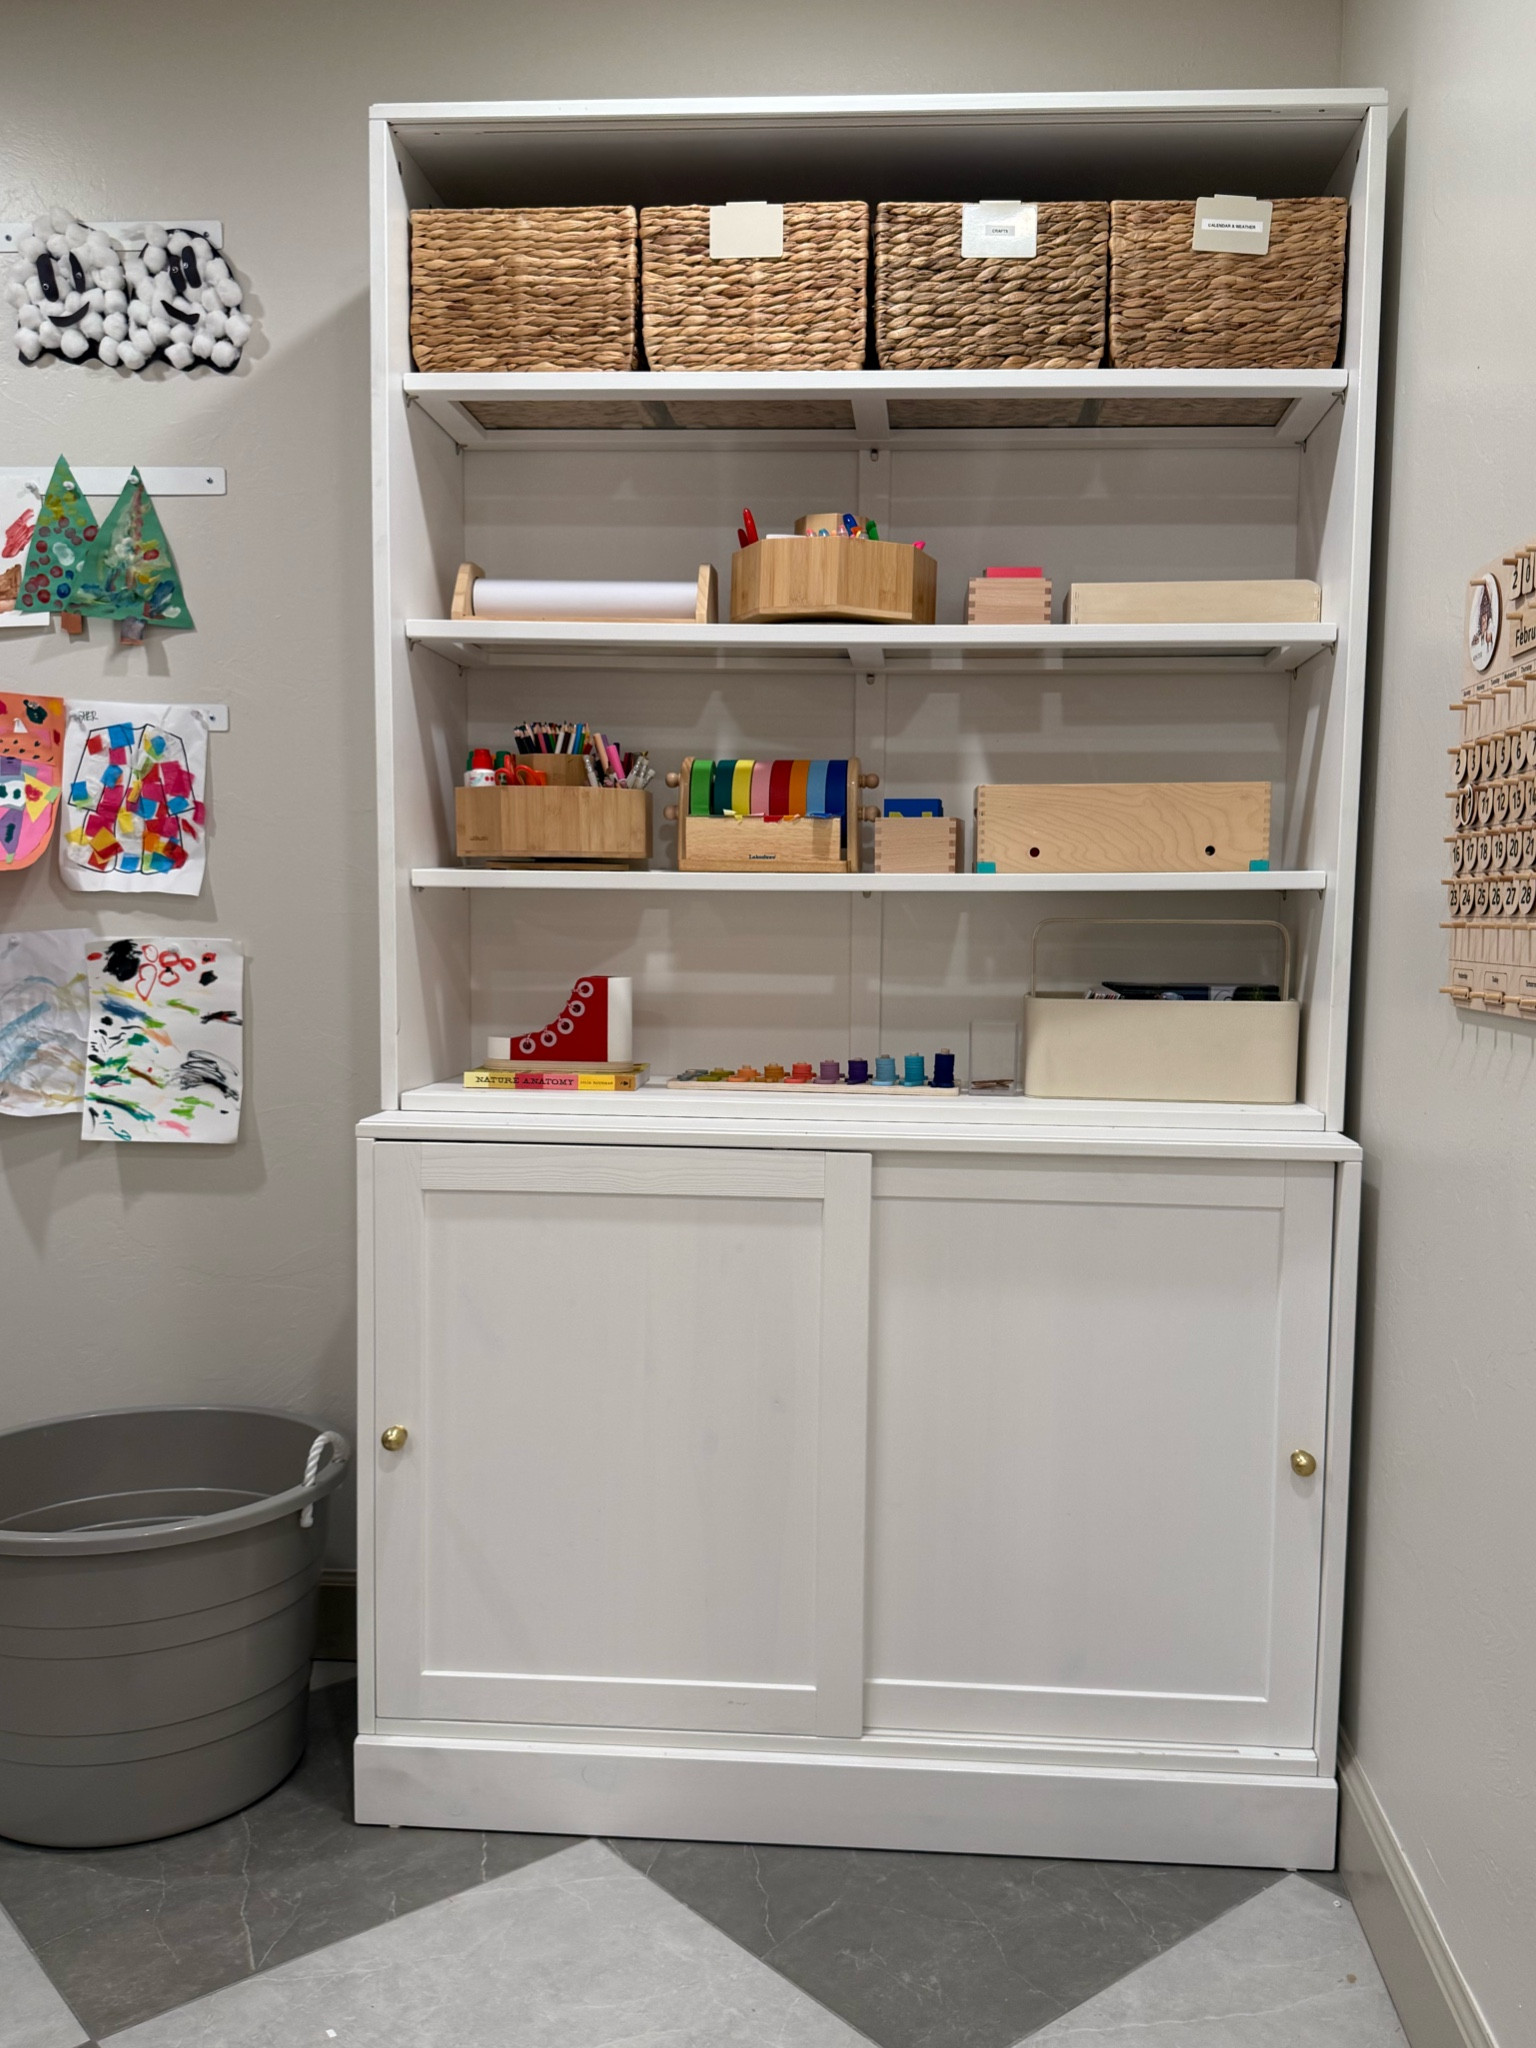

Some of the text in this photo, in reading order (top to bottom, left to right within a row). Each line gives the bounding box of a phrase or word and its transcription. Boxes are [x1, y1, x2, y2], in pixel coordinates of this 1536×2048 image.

[1482, 797, 1489, 814] 11
[1497, 793, 1505, 811] 12
[1513, 790, 1520, 809] 13
[1453, 836, 1535, 863] 16 17 18 19 20 21
[1450, 886, 1532, 906] 23 24 25 26 27 28
[475, 1076, 575, 1086] NATURE ANATOMY
